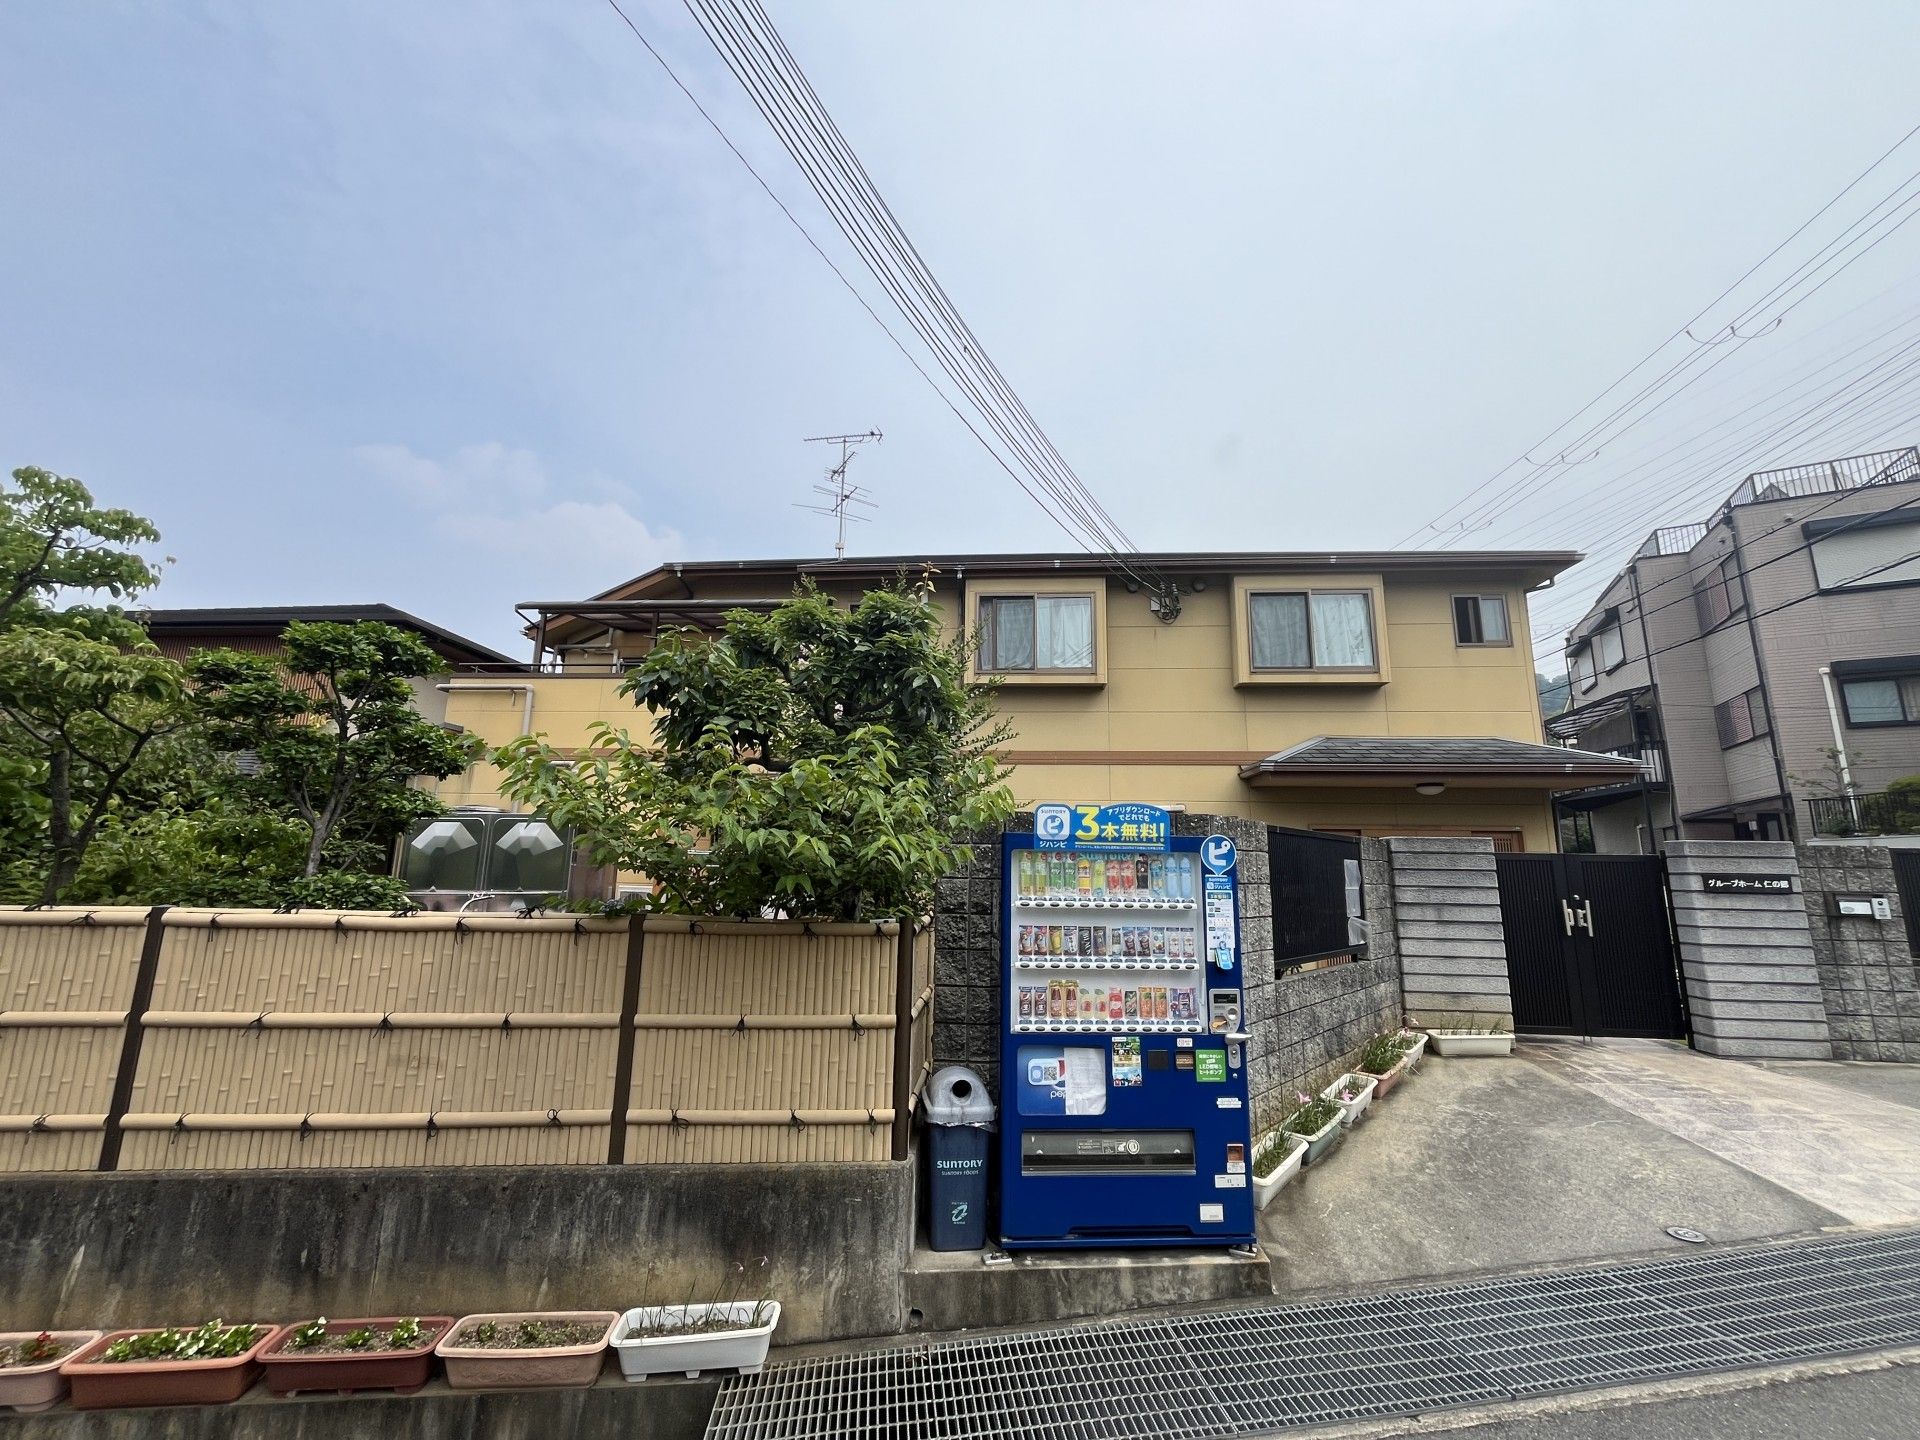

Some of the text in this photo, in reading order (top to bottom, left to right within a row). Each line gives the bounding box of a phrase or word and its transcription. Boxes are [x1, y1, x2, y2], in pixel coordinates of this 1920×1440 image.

[1107, 807, 1161, 817] アプリダウンロード
[1119, 814, 1150, 822] でどれでも
[1040, 840, 1067, 848] ジハンピ
[1708, 879, 1762, 888] グループホーム
[936, 1159, 983, 1169] SUNTORY
